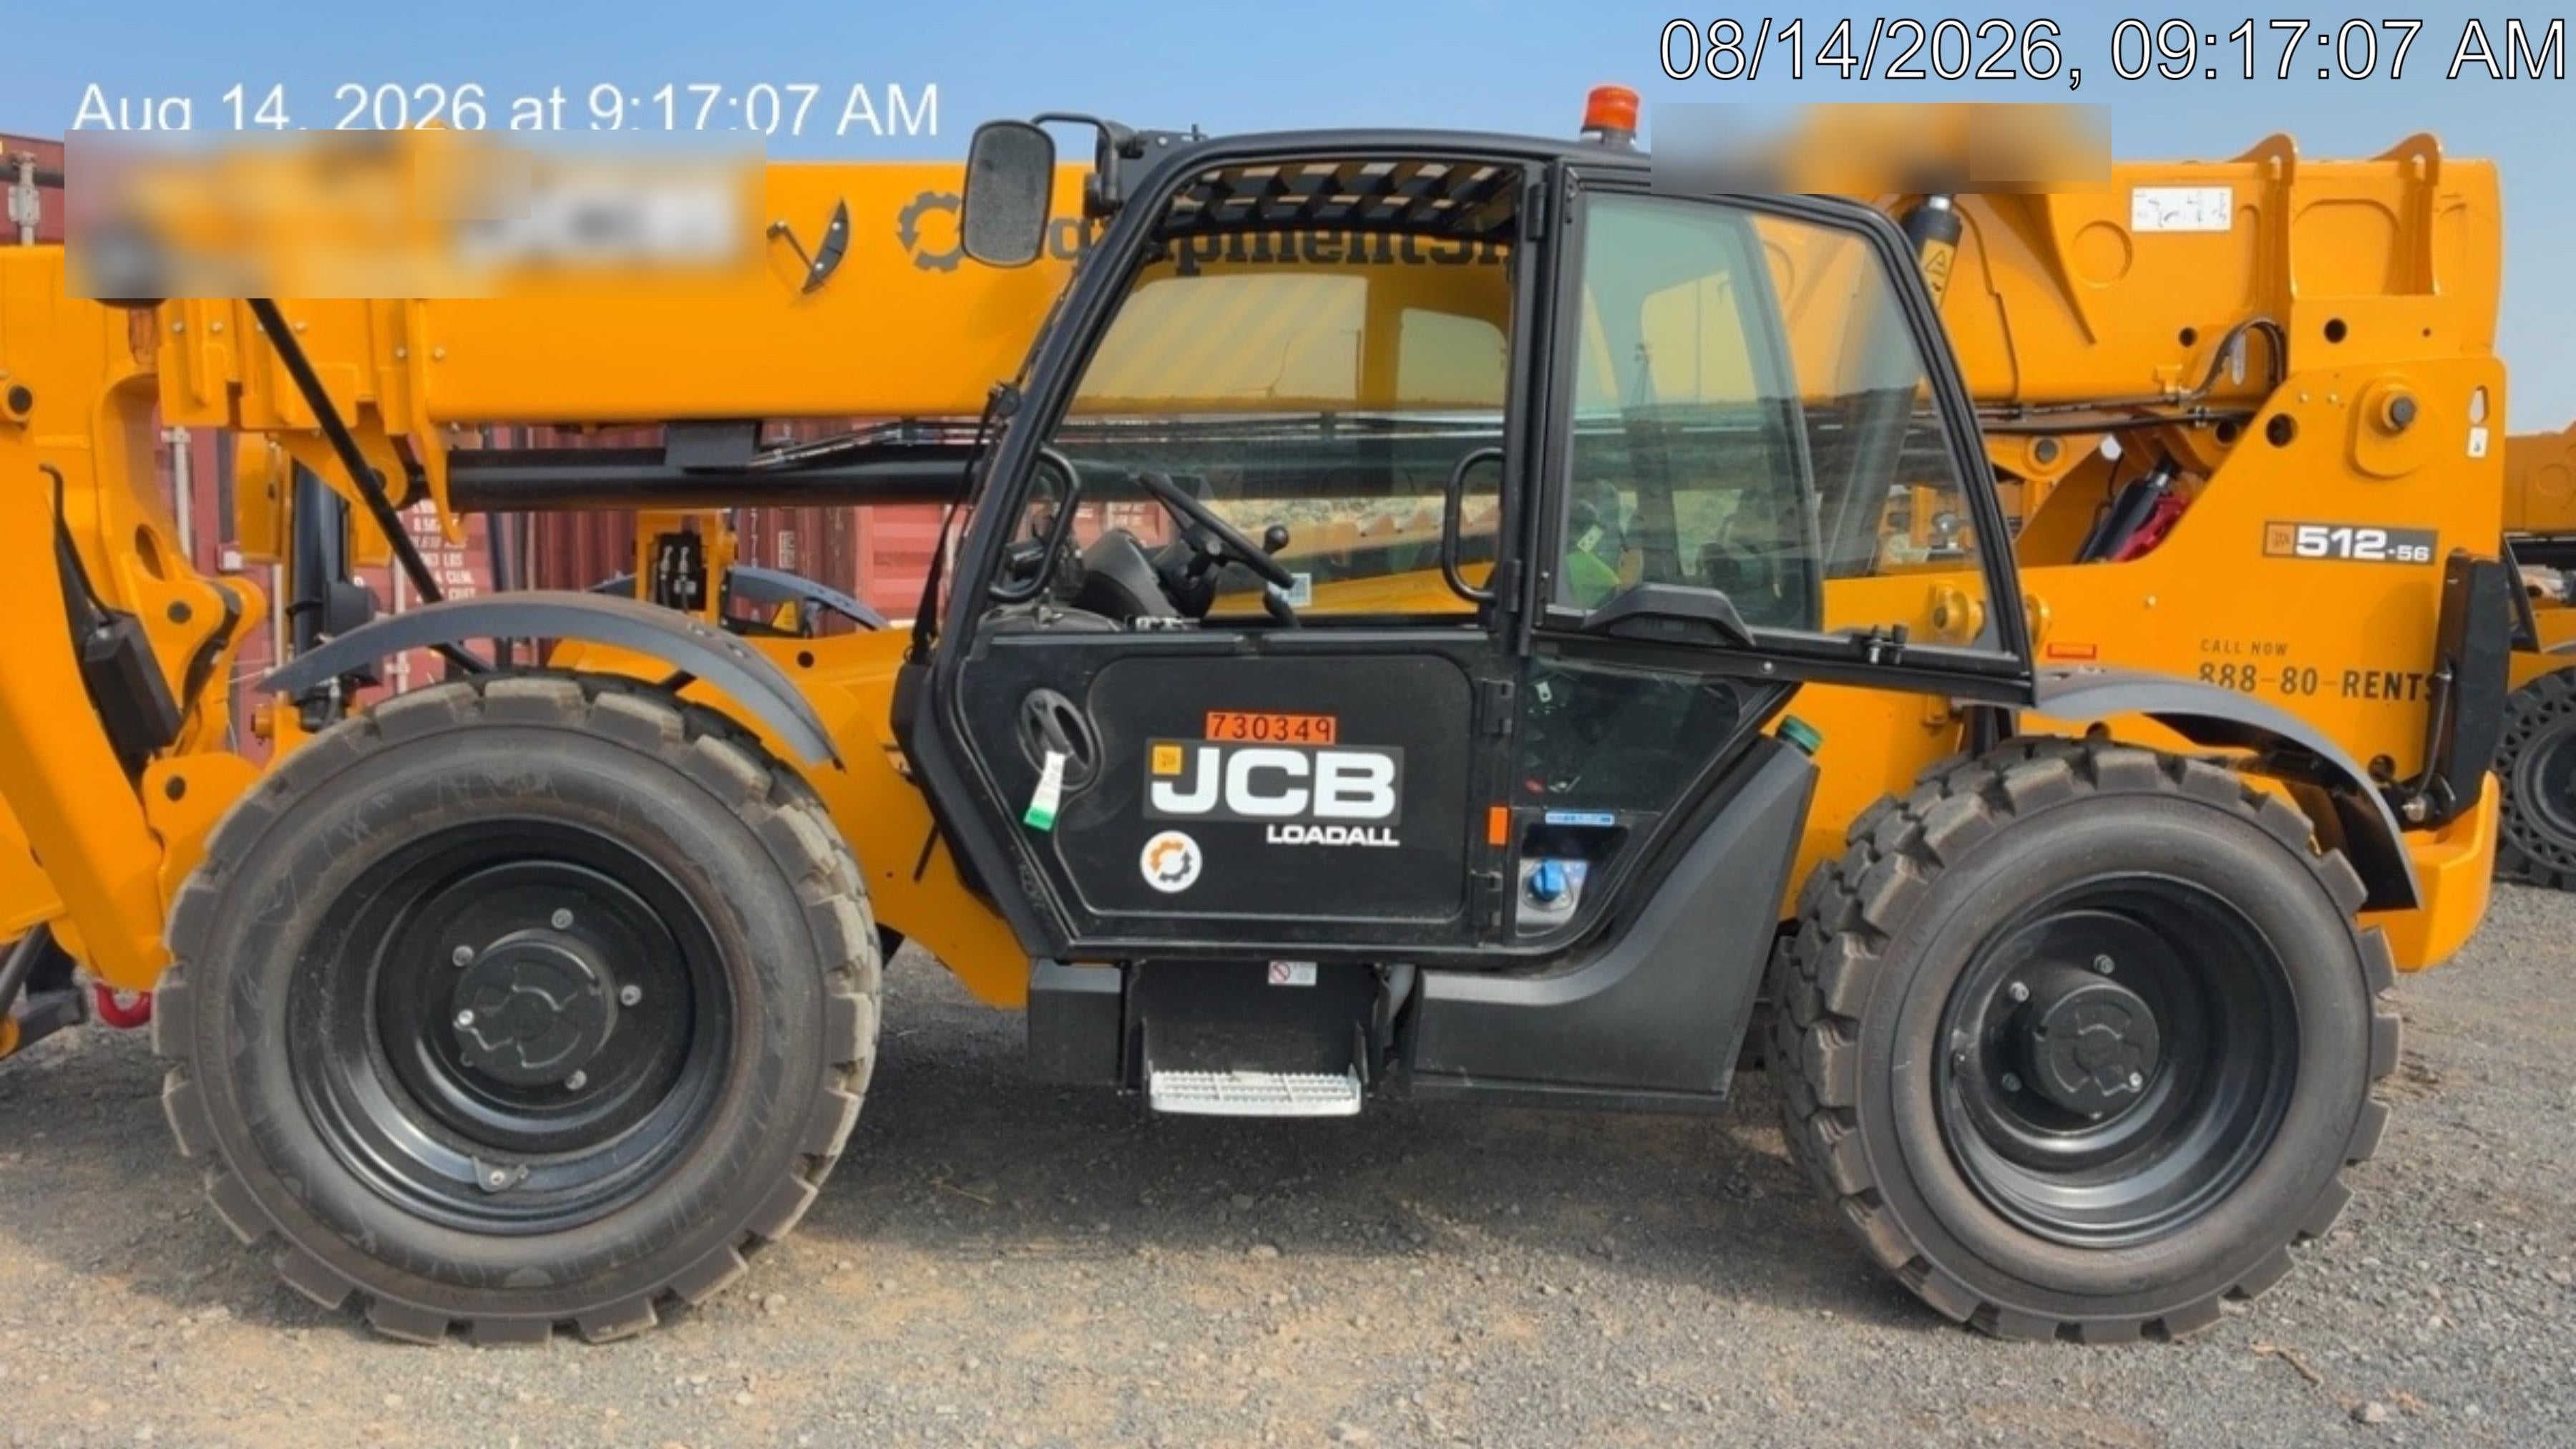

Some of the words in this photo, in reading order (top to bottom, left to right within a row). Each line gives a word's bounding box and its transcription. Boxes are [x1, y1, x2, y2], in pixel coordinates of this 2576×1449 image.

[2200, 638, 2242, 655] CALL
[2251, 641, 2288, 656] NOW
[1212, 715, 1332, 741] 730349
[1151, 747, 1396, 819] JCB
[1267, 824, 1400, 847] LOADALL
